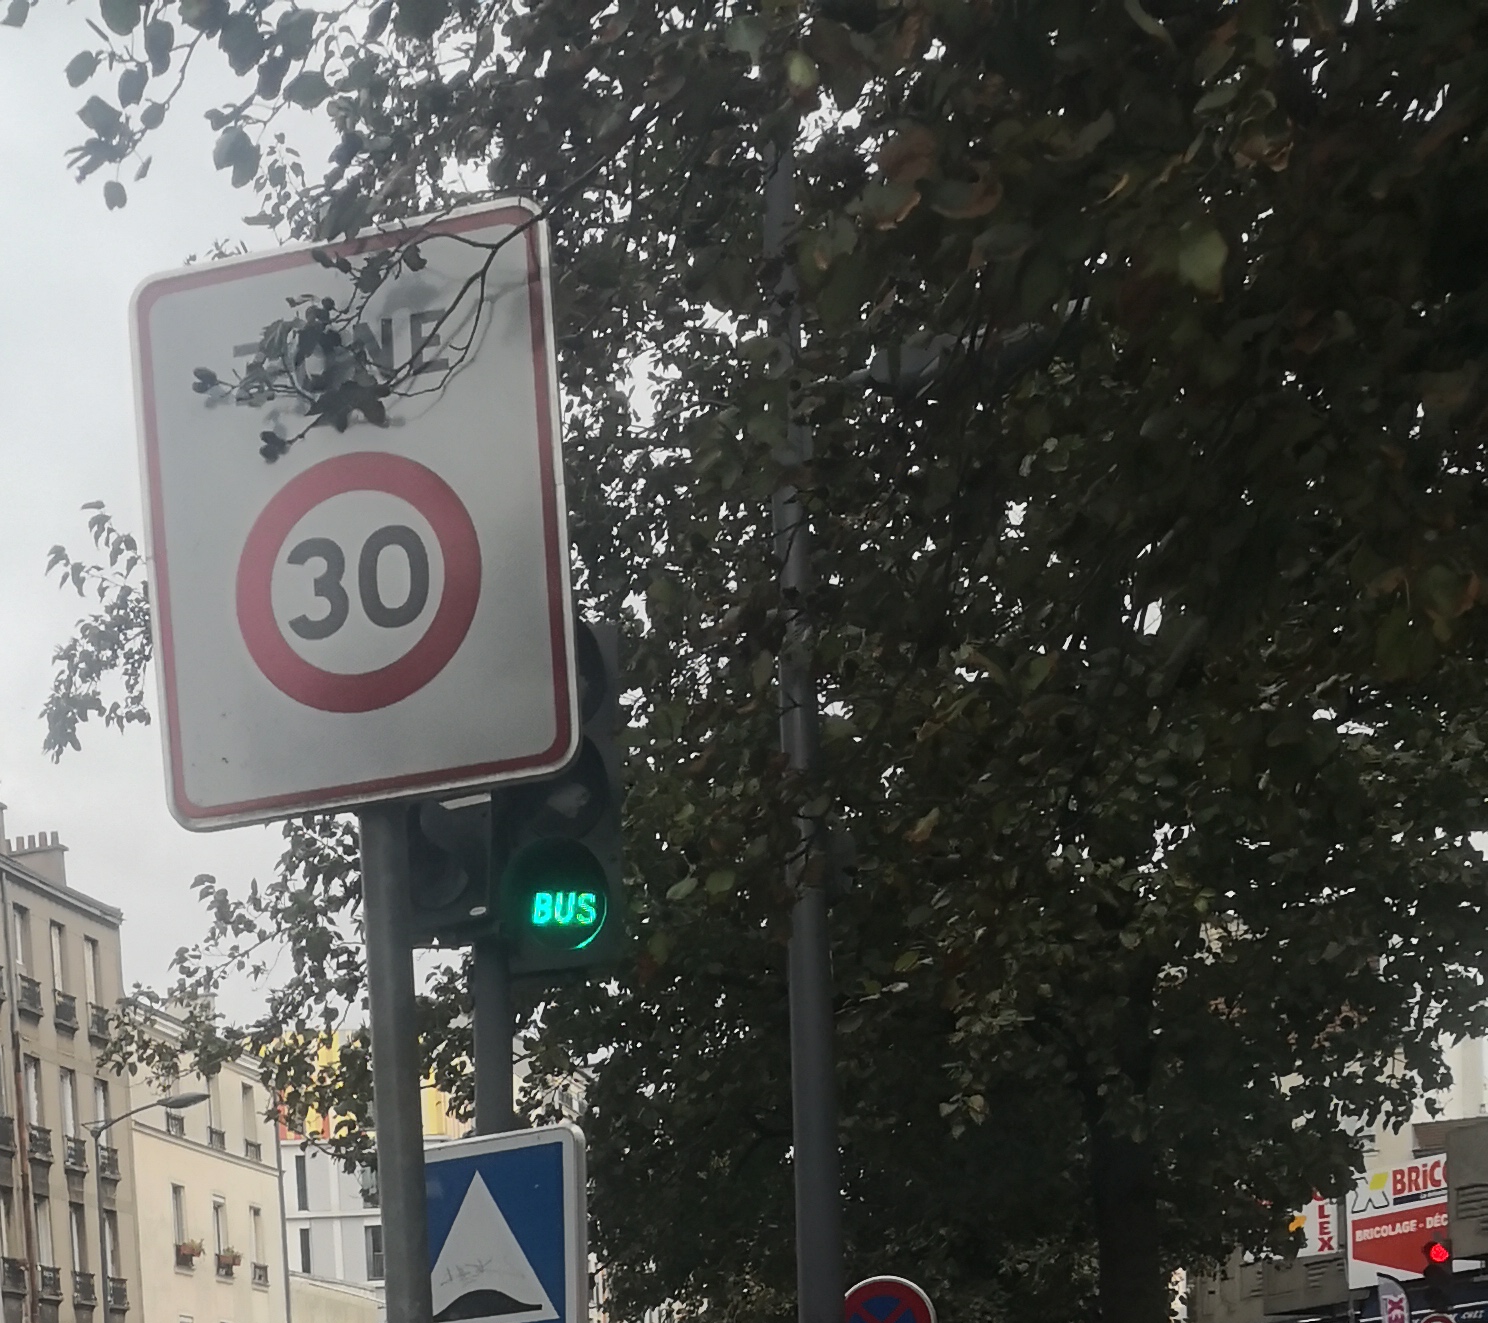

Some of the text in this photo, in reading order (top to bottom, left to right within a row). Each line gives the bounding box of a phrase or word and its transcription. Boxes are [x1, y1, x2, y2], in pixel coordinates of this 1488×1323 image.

[233, 309, 449, 392] NE
[287, 525, 429, 640] 30
[533, 891, 596, 924] BUS
[1355, 1219, 1417, 1242] BRICOLAGE
